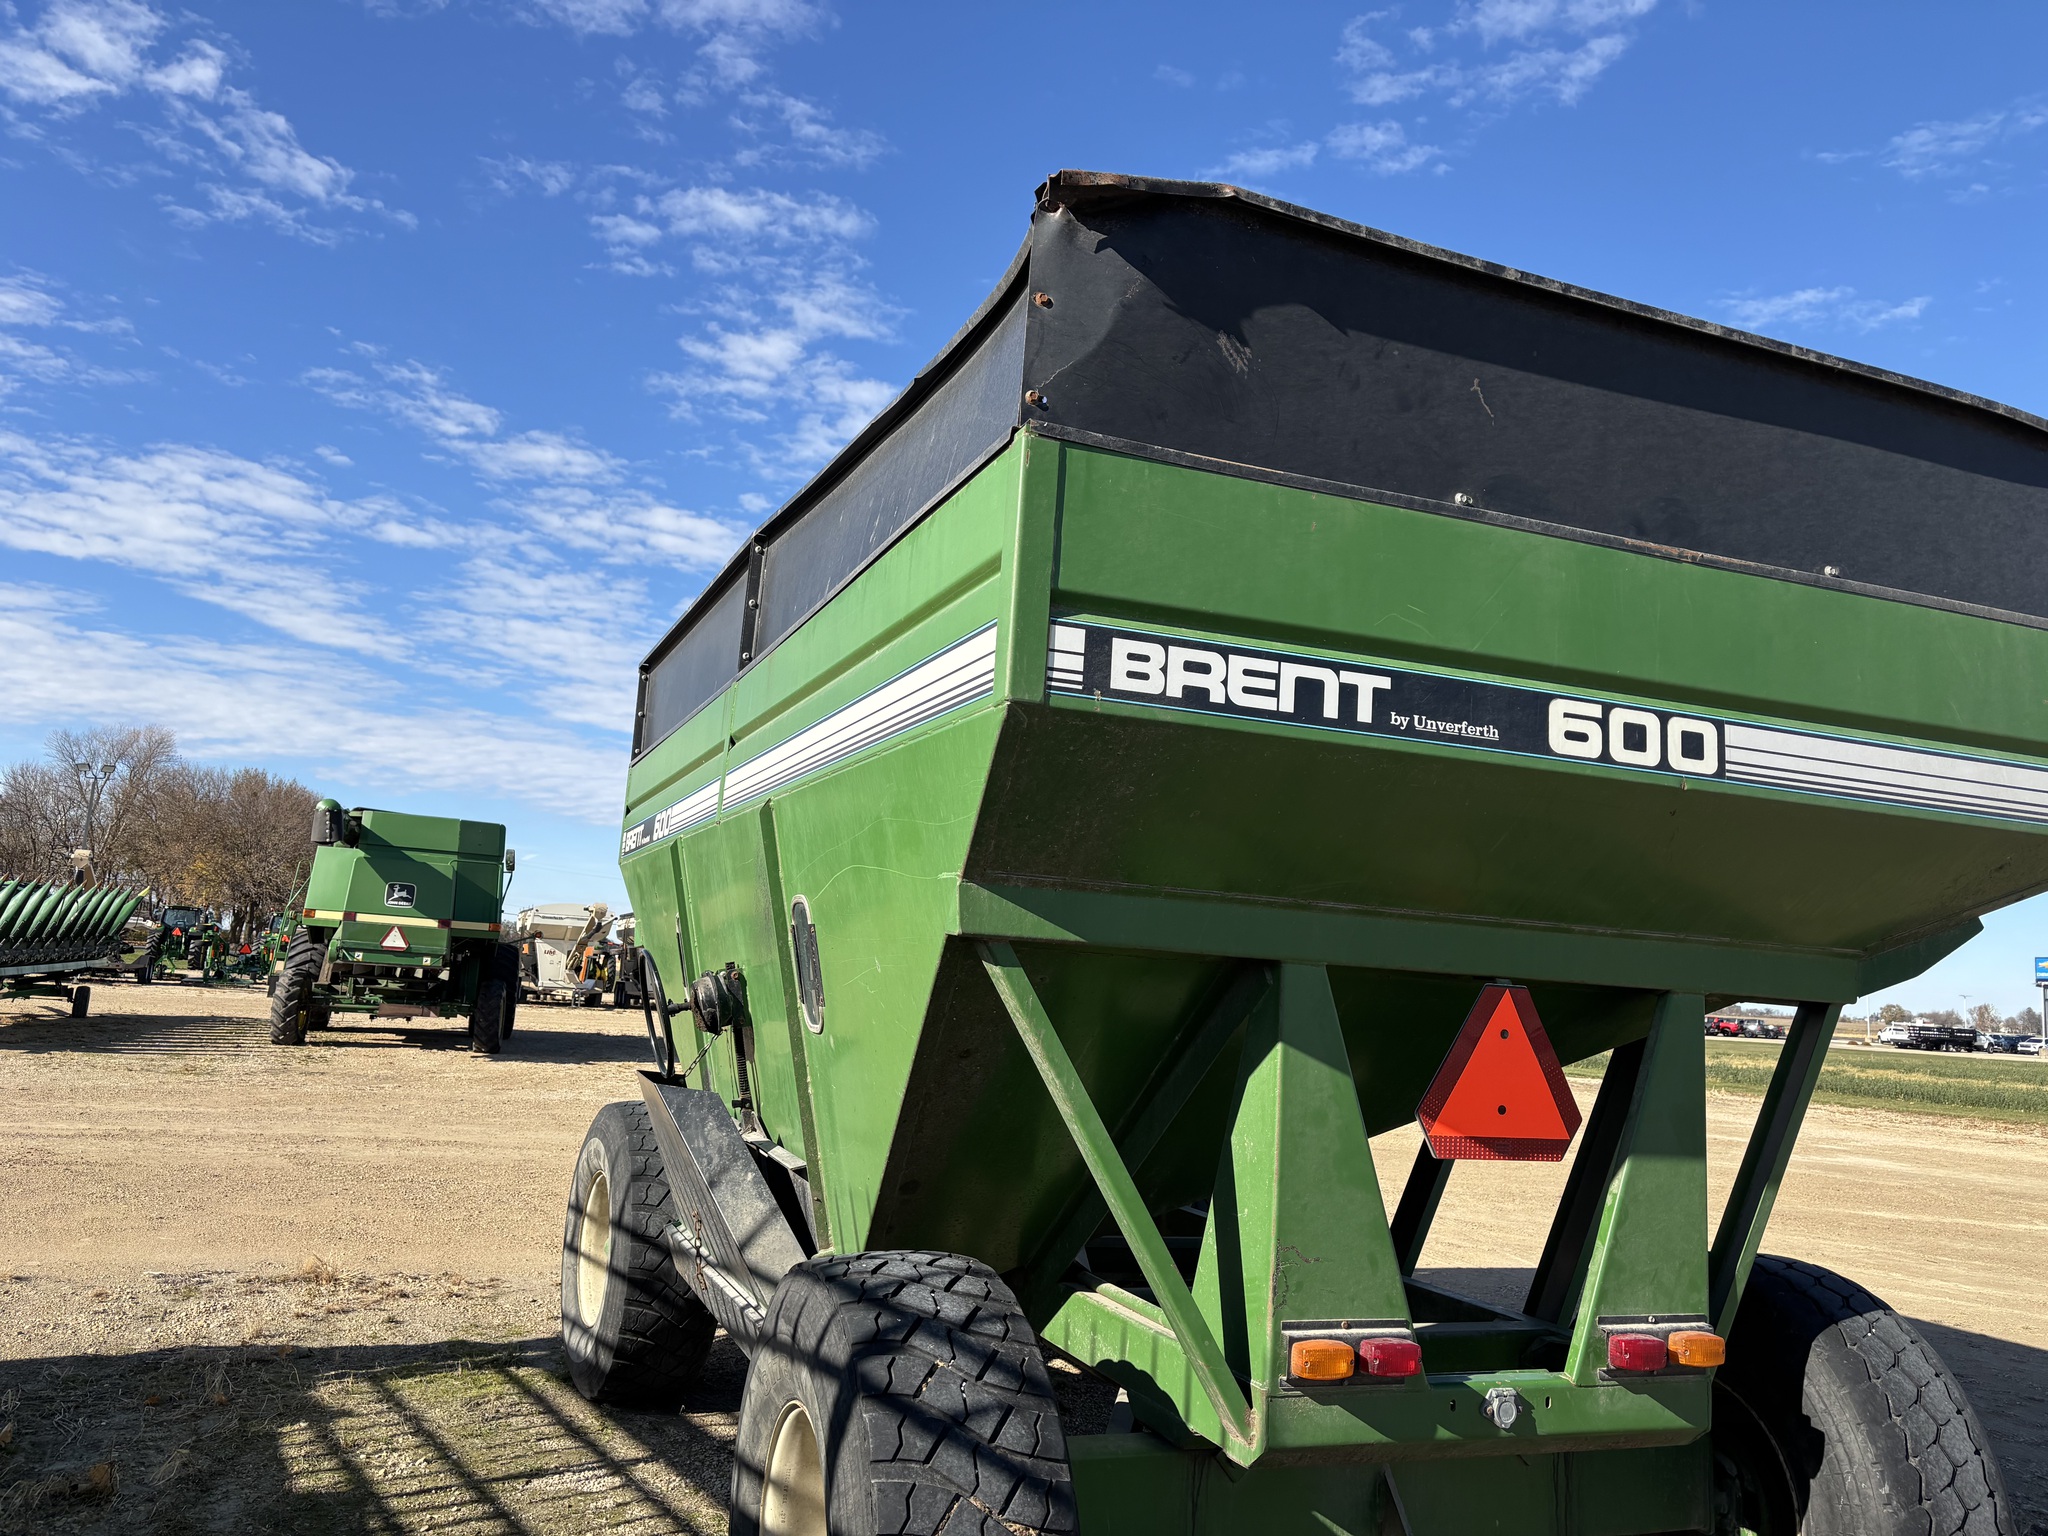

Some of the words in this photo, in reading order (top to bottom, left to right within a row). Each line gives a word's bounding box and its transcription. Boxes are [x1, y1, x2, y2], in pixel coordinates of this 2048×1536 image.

[1110, 637, 1392, 724] BRENT
[1390, 711, 1410, 730] by
[1414, 715, 1500, 740] Unverferth
[1548, 698, 1718, 775] 600
[652, 807, 671, 841] 600
